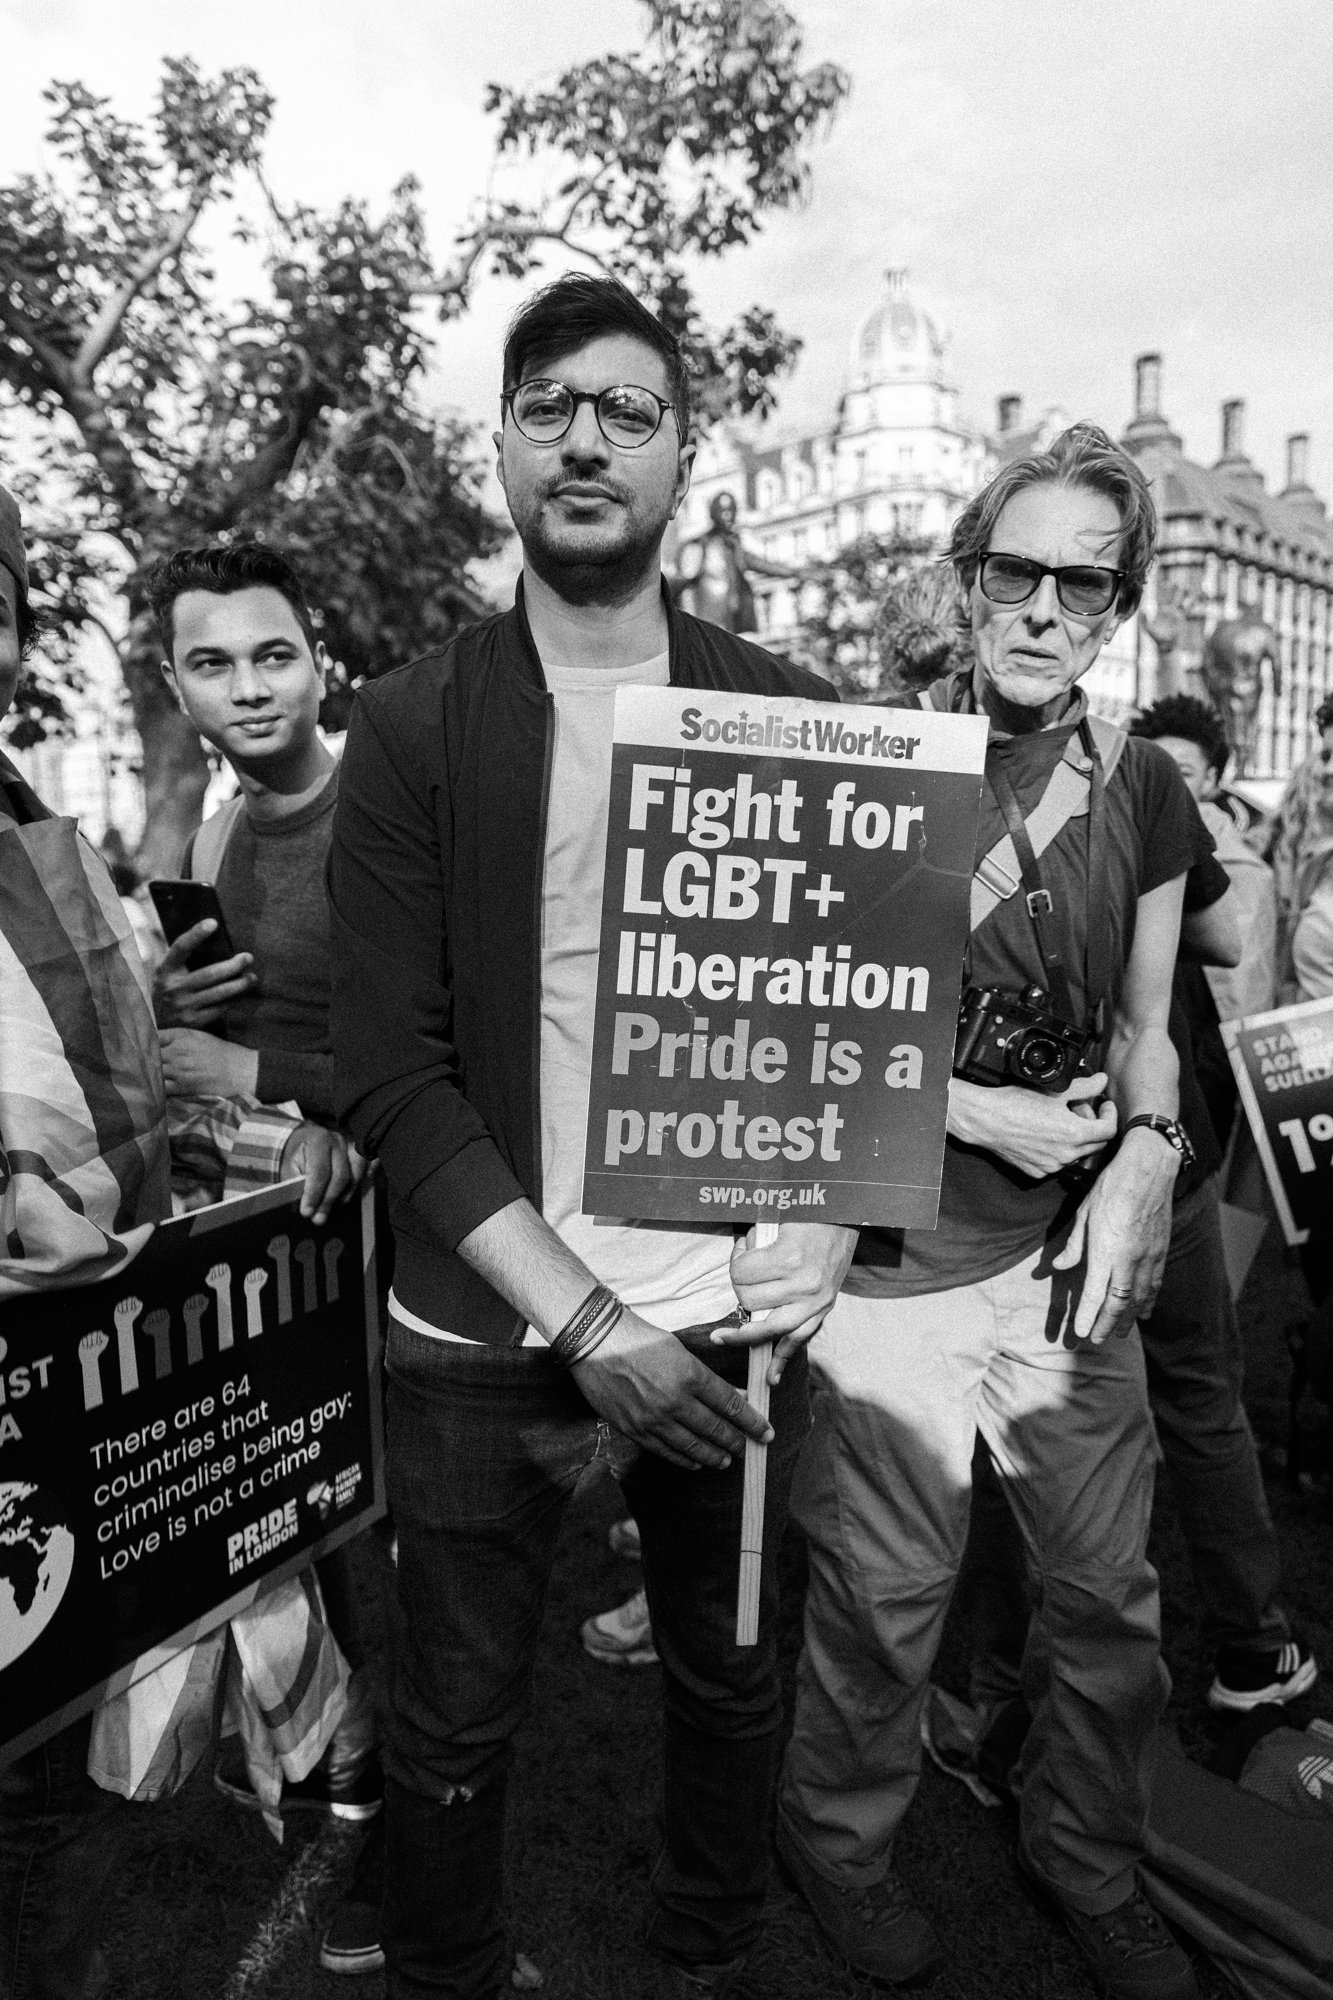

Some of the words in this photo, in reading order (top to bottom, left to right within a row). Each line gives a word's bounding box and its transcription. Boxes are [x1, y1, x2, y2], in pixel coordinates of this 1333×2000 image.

[628, 763, 804, 849] Fight
[826, 781, 925, 852] for
[622, 847, 845, 924] LGBT+
[616, 930, 930, 1012] liberation
[611, 1011, 788, 1084] Pride
[810, 1023, 863, 1086] is
[884, 1044, 924, 1090] a
[604, 1099, 845, 1166] protest
[698, 1183, 826, 1210] swp.org.uk
[90, 1419, 167, 1470] There
[174, 1396, 215, 1430] are
[222, 1374, 251, 1406] 64
[93, 1430, 216, 1507] countries
[221, 1399, 269, 1441] that
[97, 1454, 237, 1543] criminalise
[242, 1416, 305, 1465] being
[309, 1391, 352, 1434] gay:
[100, 1531, 161, 1580] Love
[167, 1516, 187, 1541] is
[194, 1487, 233, 1526] not
[239, 1477, 254, 1499] a
[260, 1440, 321, 1487] crime
[229, 1554, 244, 1576] IN
[246, 1521, 299, 1565] LONDON
